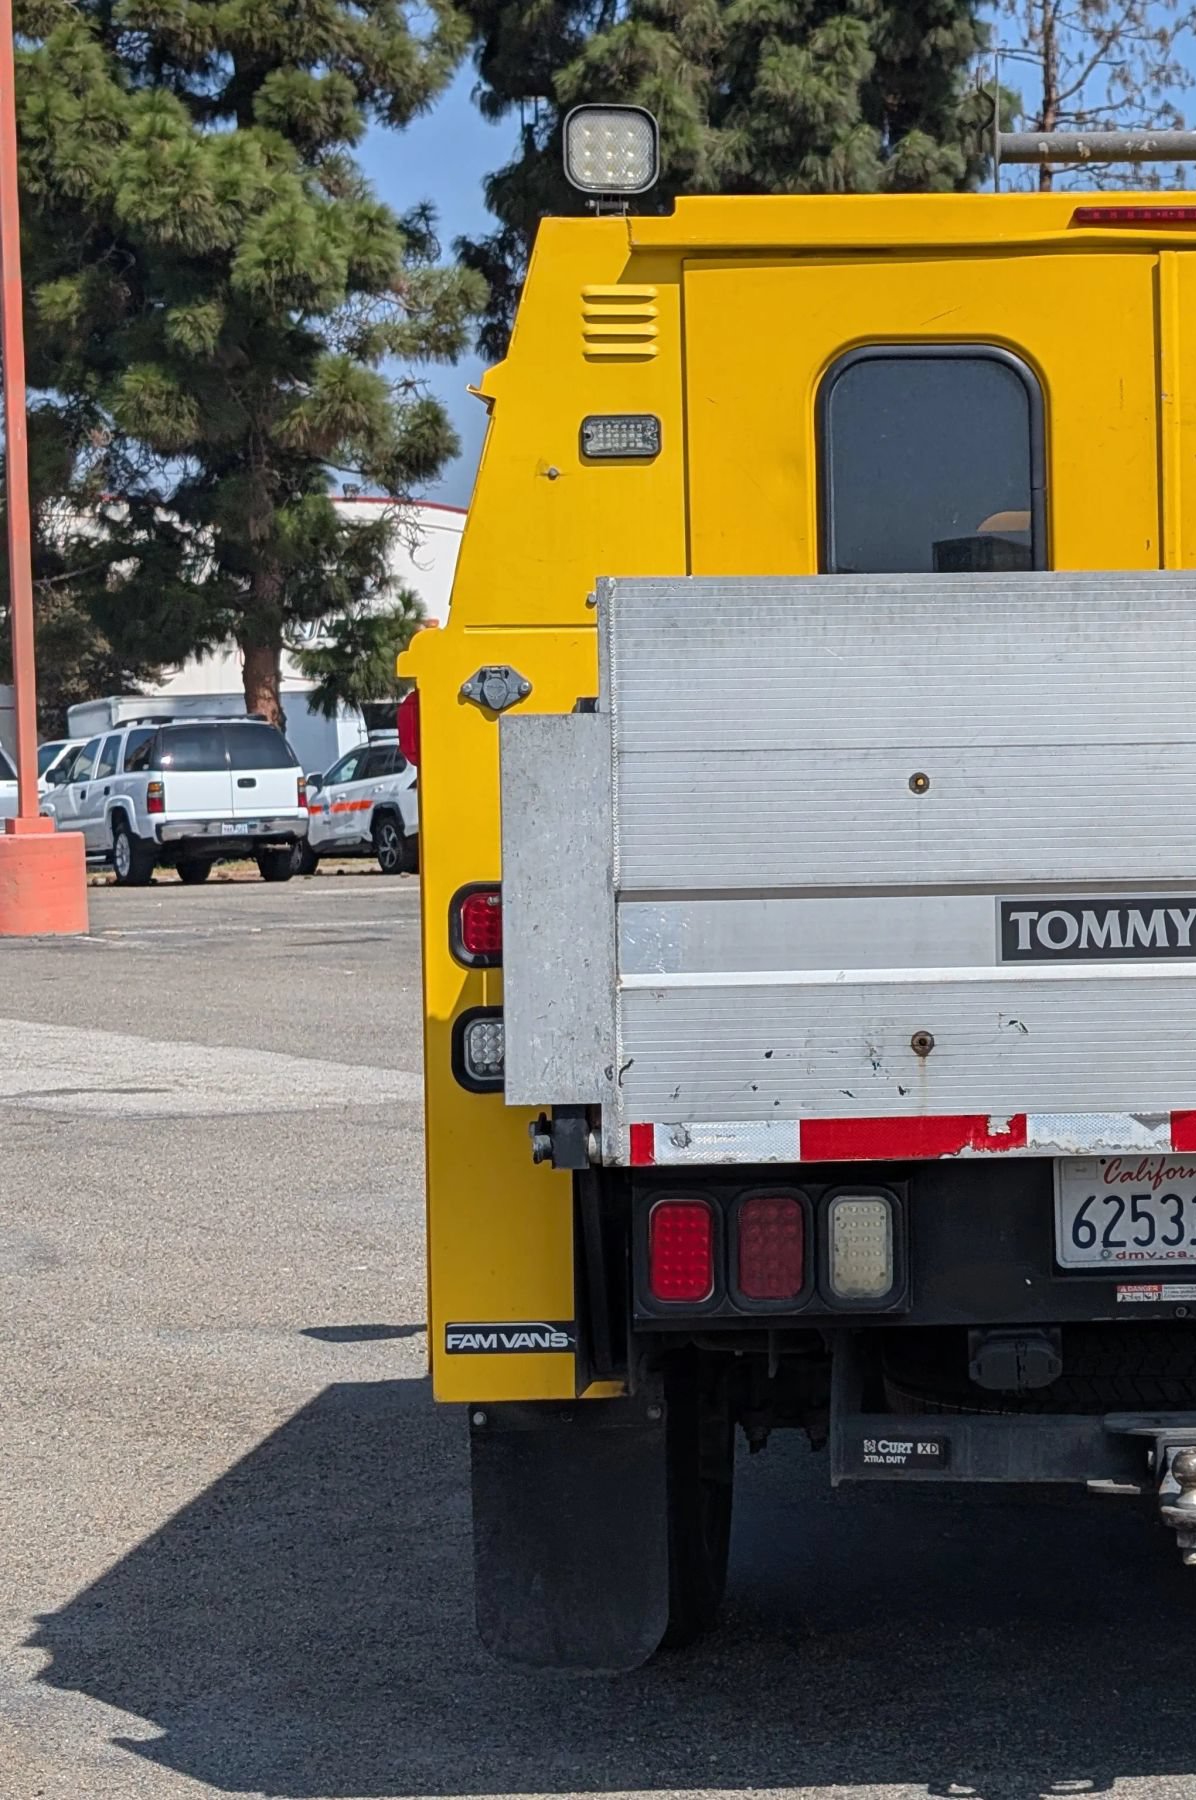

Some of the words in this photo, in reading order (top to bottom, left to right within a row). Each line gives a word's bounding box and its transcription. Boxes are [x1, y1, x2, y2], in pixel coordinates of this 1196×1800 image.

[1127, 1284, 1159, 1293] DANGER
[878, 1439, 914, 1454] CURT
[919, 1443, 938, 1454] XD
[863, 1455, 885, 1464] XTRA
[886, 1455, 907, 1464] DUTY
